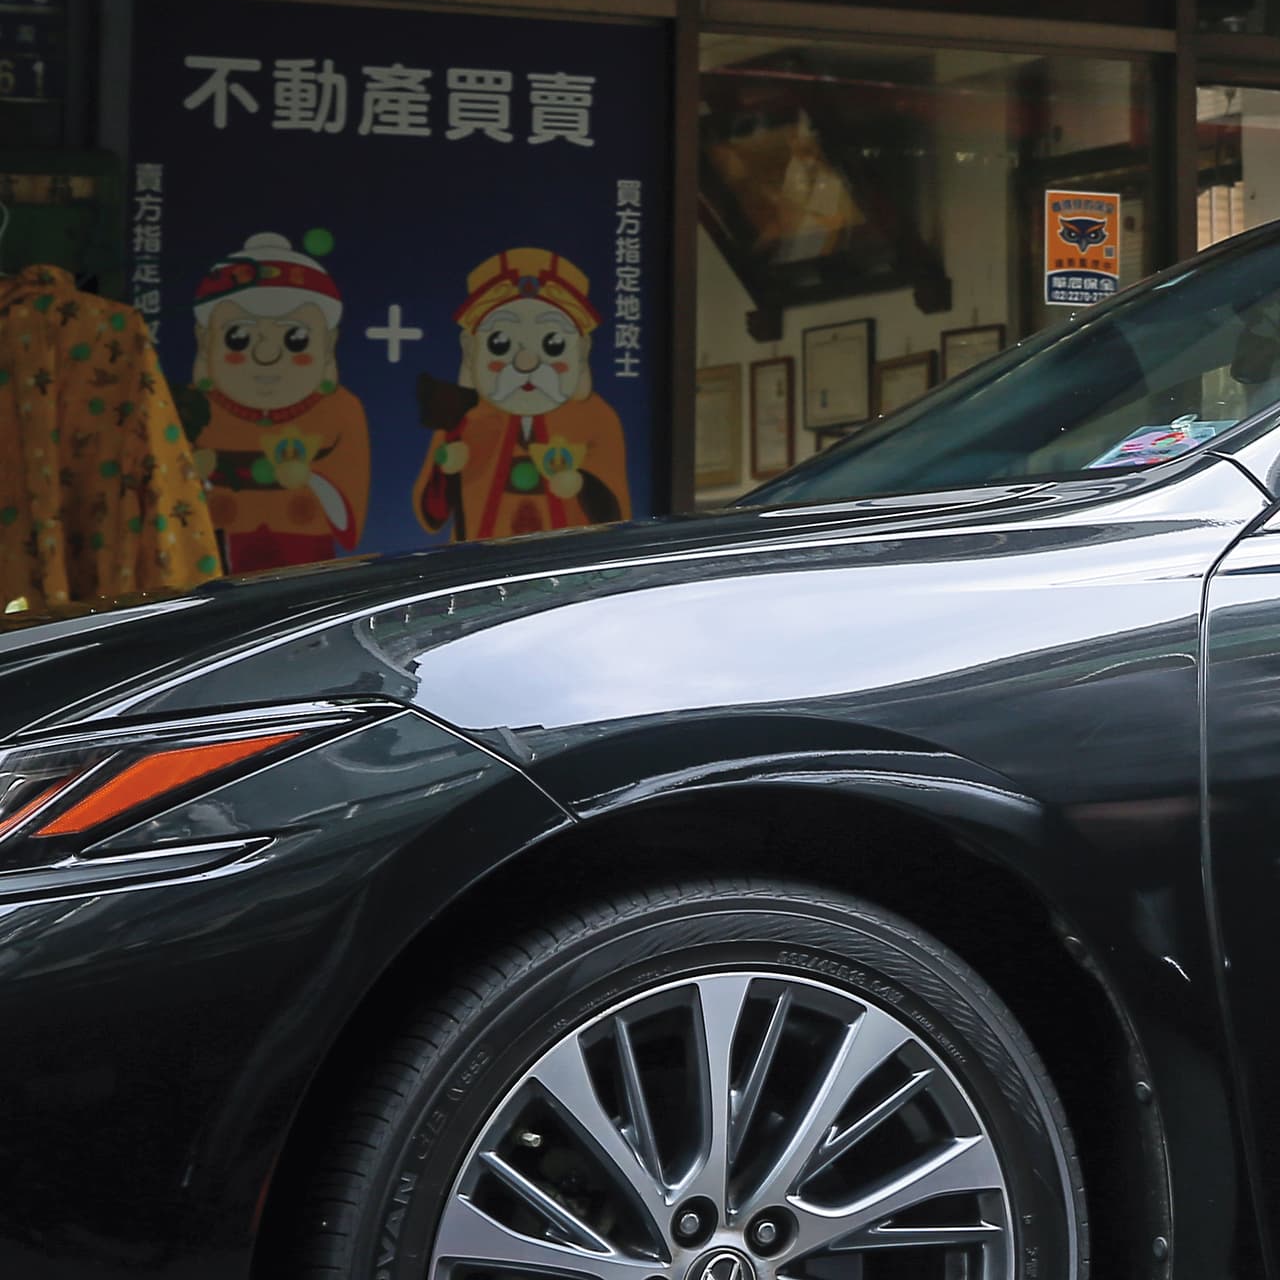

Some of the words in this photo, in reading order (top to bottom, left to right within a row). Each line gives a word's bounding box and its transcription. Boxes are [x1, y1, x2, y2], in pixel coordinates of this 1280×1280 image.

[184, 55, 597, 147] 不動產買賣
[613, 179, 643, 379] 買方指定地政士
